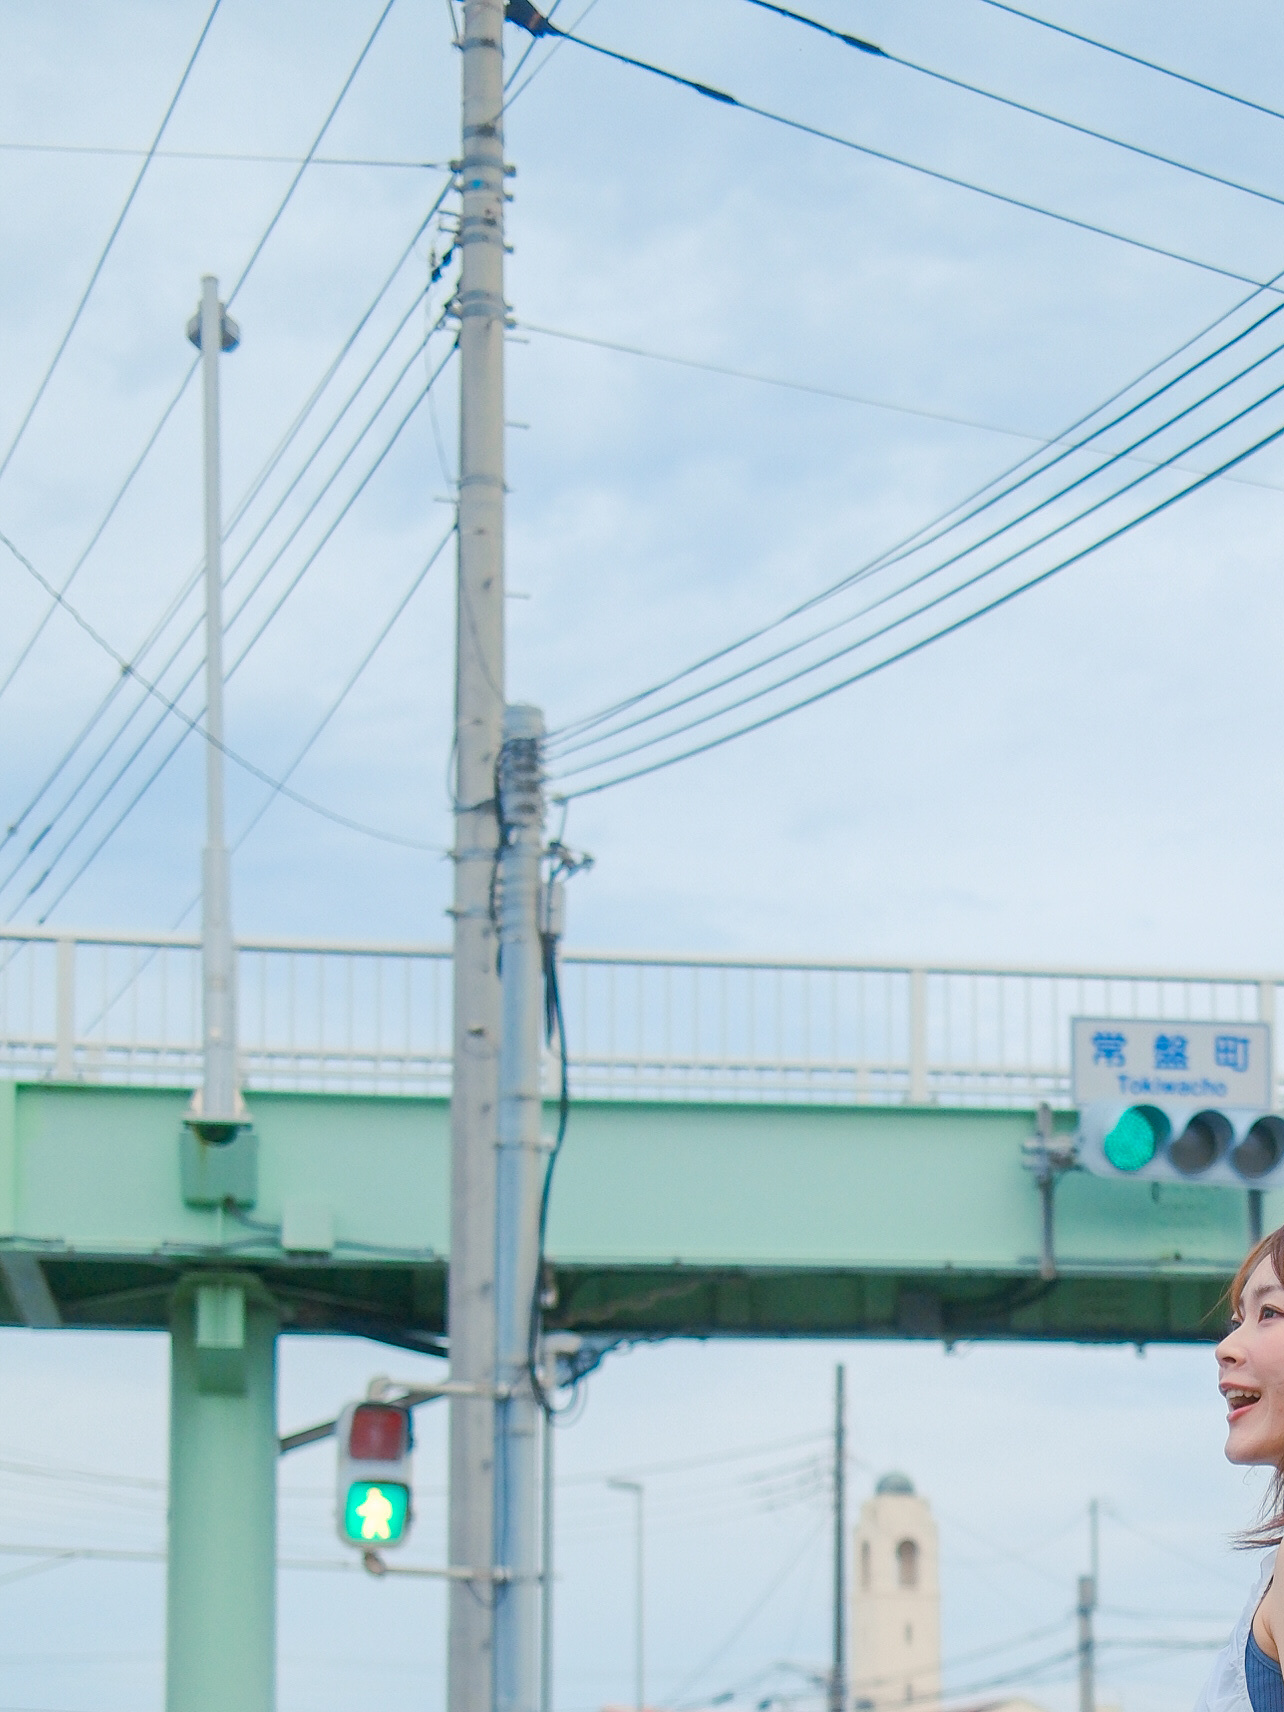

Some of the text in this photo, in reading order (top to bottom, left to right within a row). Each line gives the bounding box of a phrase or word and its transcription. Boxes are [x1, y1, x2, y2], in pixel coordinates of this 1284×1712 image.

[1092, 1032, 1250, 1072] 常盤町
[1117, 1074, 1227, 1096] Tokiwacho
